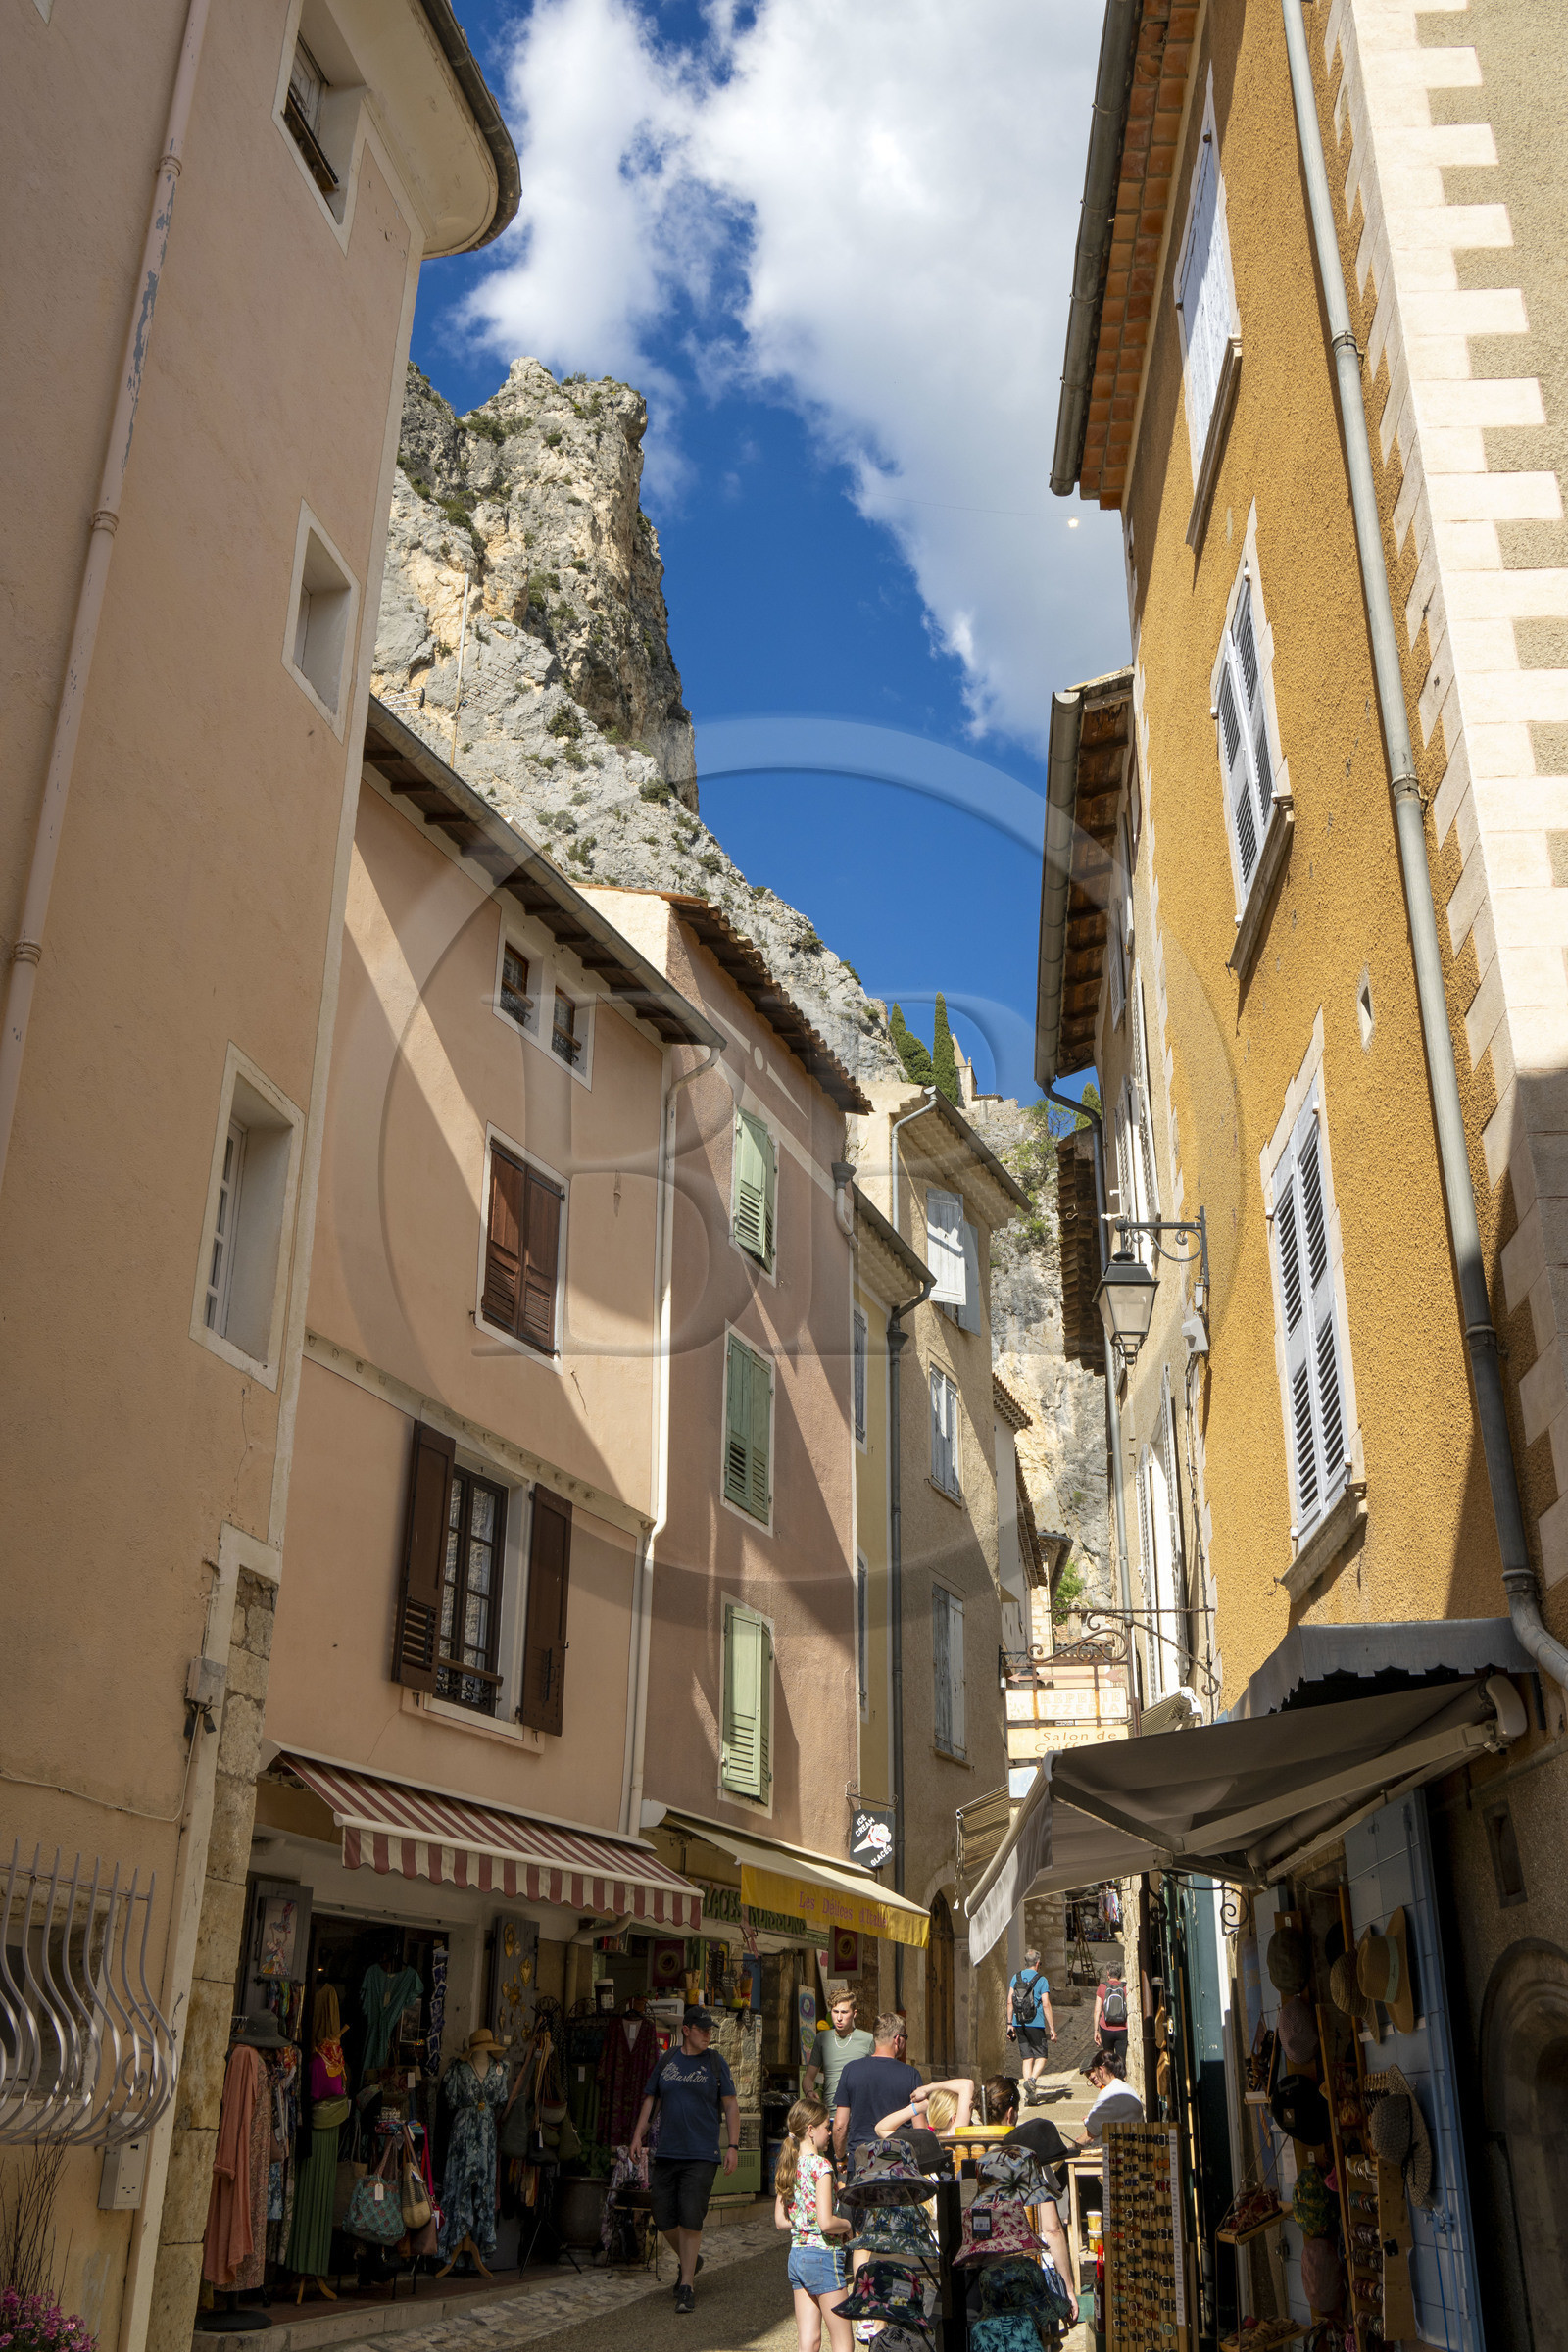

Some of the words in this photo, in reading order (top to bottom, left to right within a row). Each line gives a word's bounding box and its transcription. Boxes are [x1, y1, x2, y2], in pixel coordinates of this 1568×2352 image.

[1043, 1732, 1089, 1741] Salon
[1097, 1731, 1117, 1740] de
[1035, 1742, 1081, 1753] Coiff
[855, 1816, 875, 1837] CREAM
[856, 1814, 867, 1826] ICE
[870, 1845, 893, 1866] GLACES
[799, 1891, 815, 1910] Les
[822, 1897, 853, 1920] Délices
[859, 1907, 887, 1929] d'Italie
